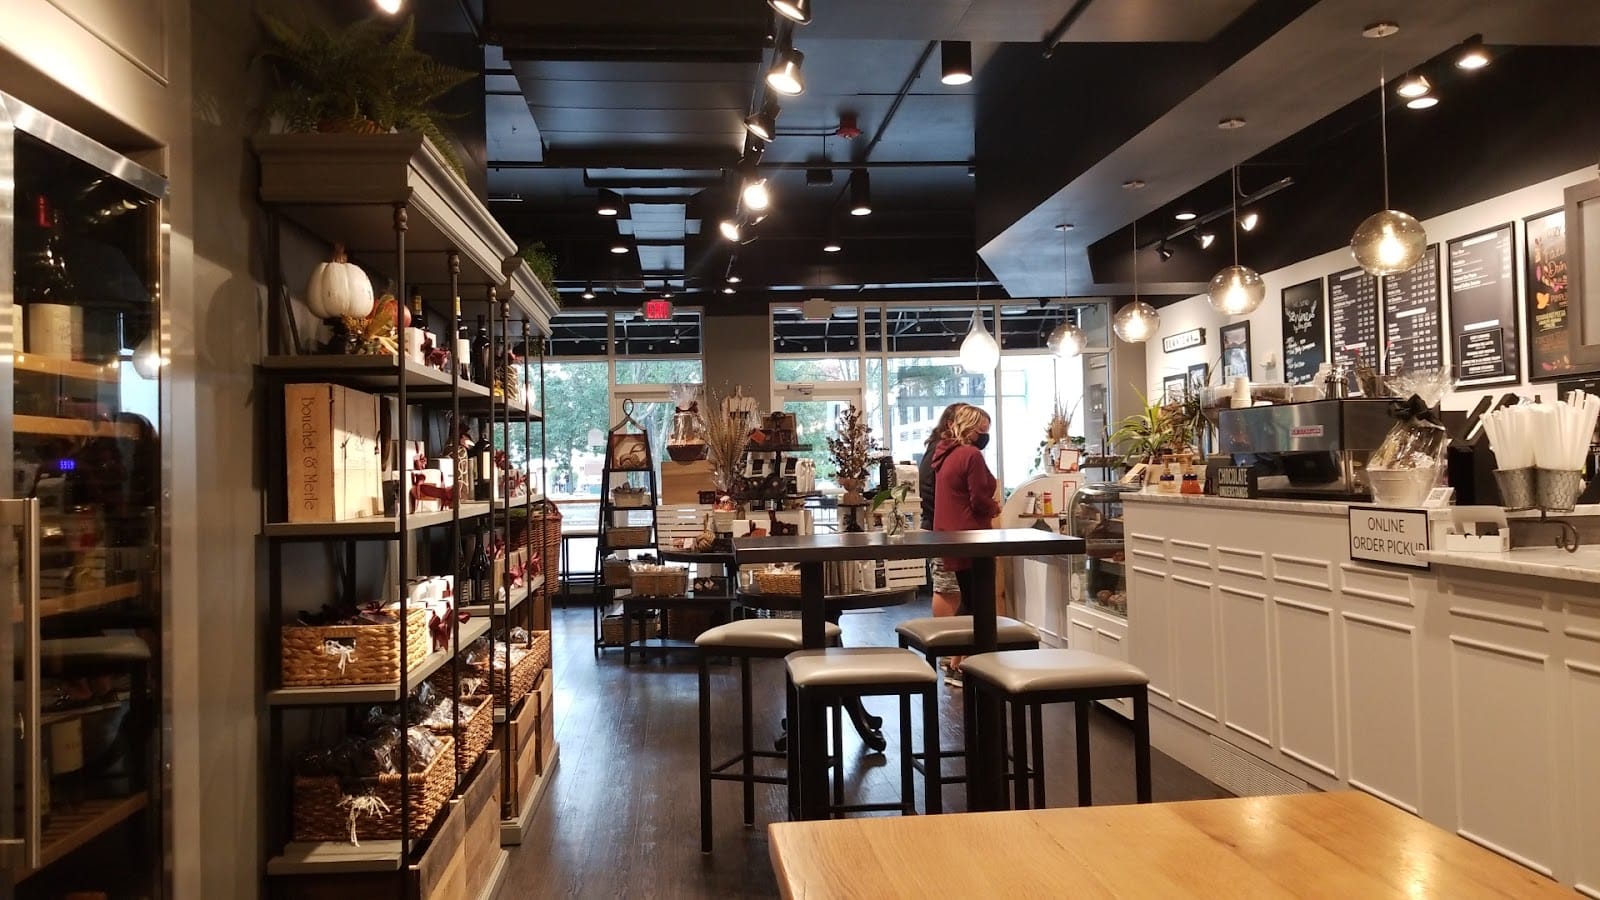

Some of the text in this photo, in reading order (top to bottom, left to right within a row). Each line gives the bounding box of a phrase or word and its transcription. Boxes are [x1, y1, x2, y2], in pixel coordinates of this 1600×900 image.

[301, 396, 319, 511] Bouchet & Merle
[1218, 467, 1249, 486] CHOCOLATE
[1219, 485, 1249, 498] UNDERSTANDS
[1367, 516, 1406, 534] ONLINE
[1353, 535, 1426, 557] ORDER PICKUP
